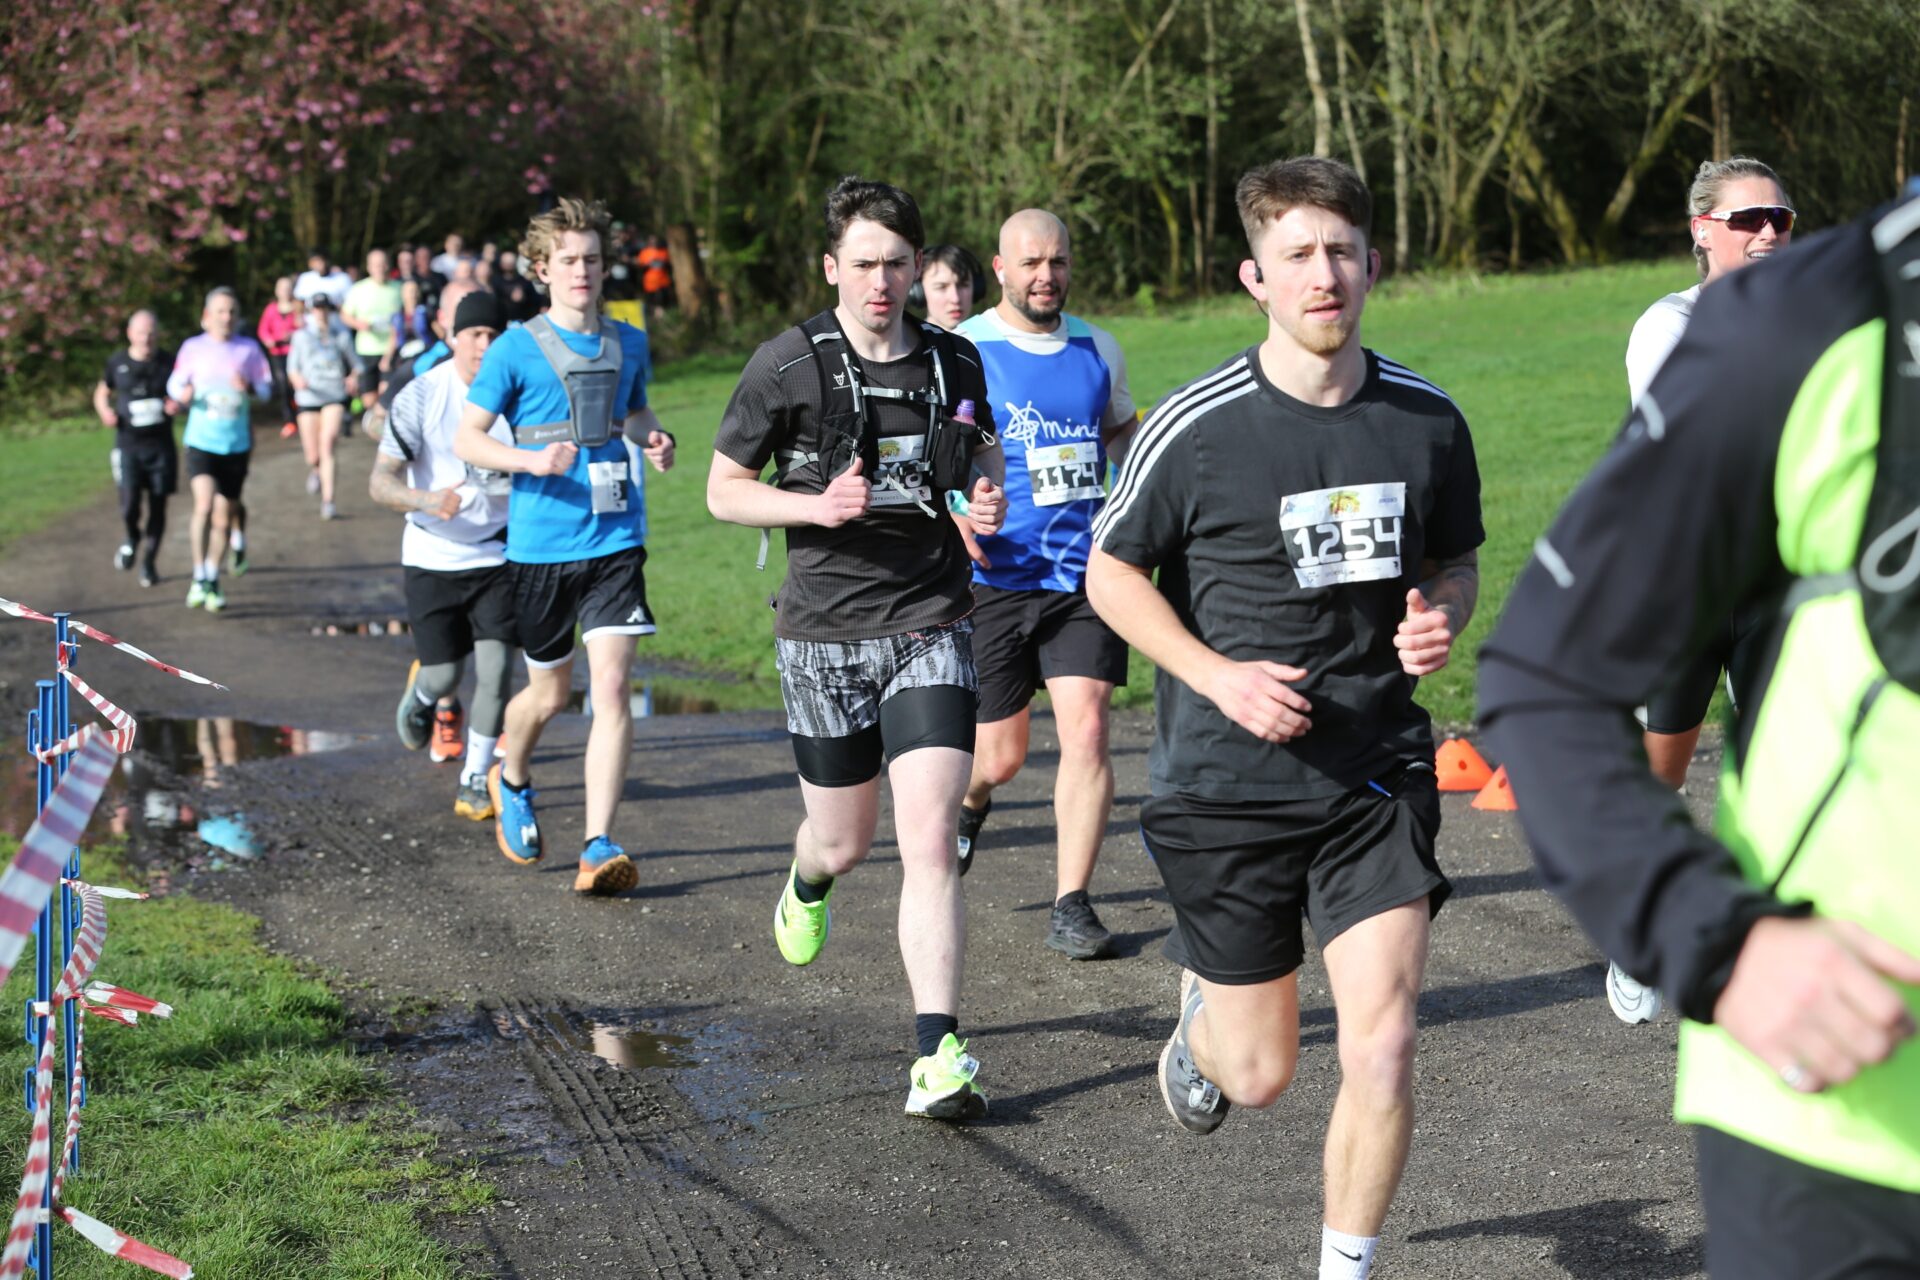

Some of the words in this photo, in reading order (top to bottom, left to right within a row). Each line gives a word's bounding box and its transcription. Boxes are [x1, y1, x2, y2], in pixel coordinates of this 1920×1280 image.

[1042, 416, 1100, 440] mind
[1037, 462, 1098, 493] 1174
[1293, 516, 1401, 568] 1254
